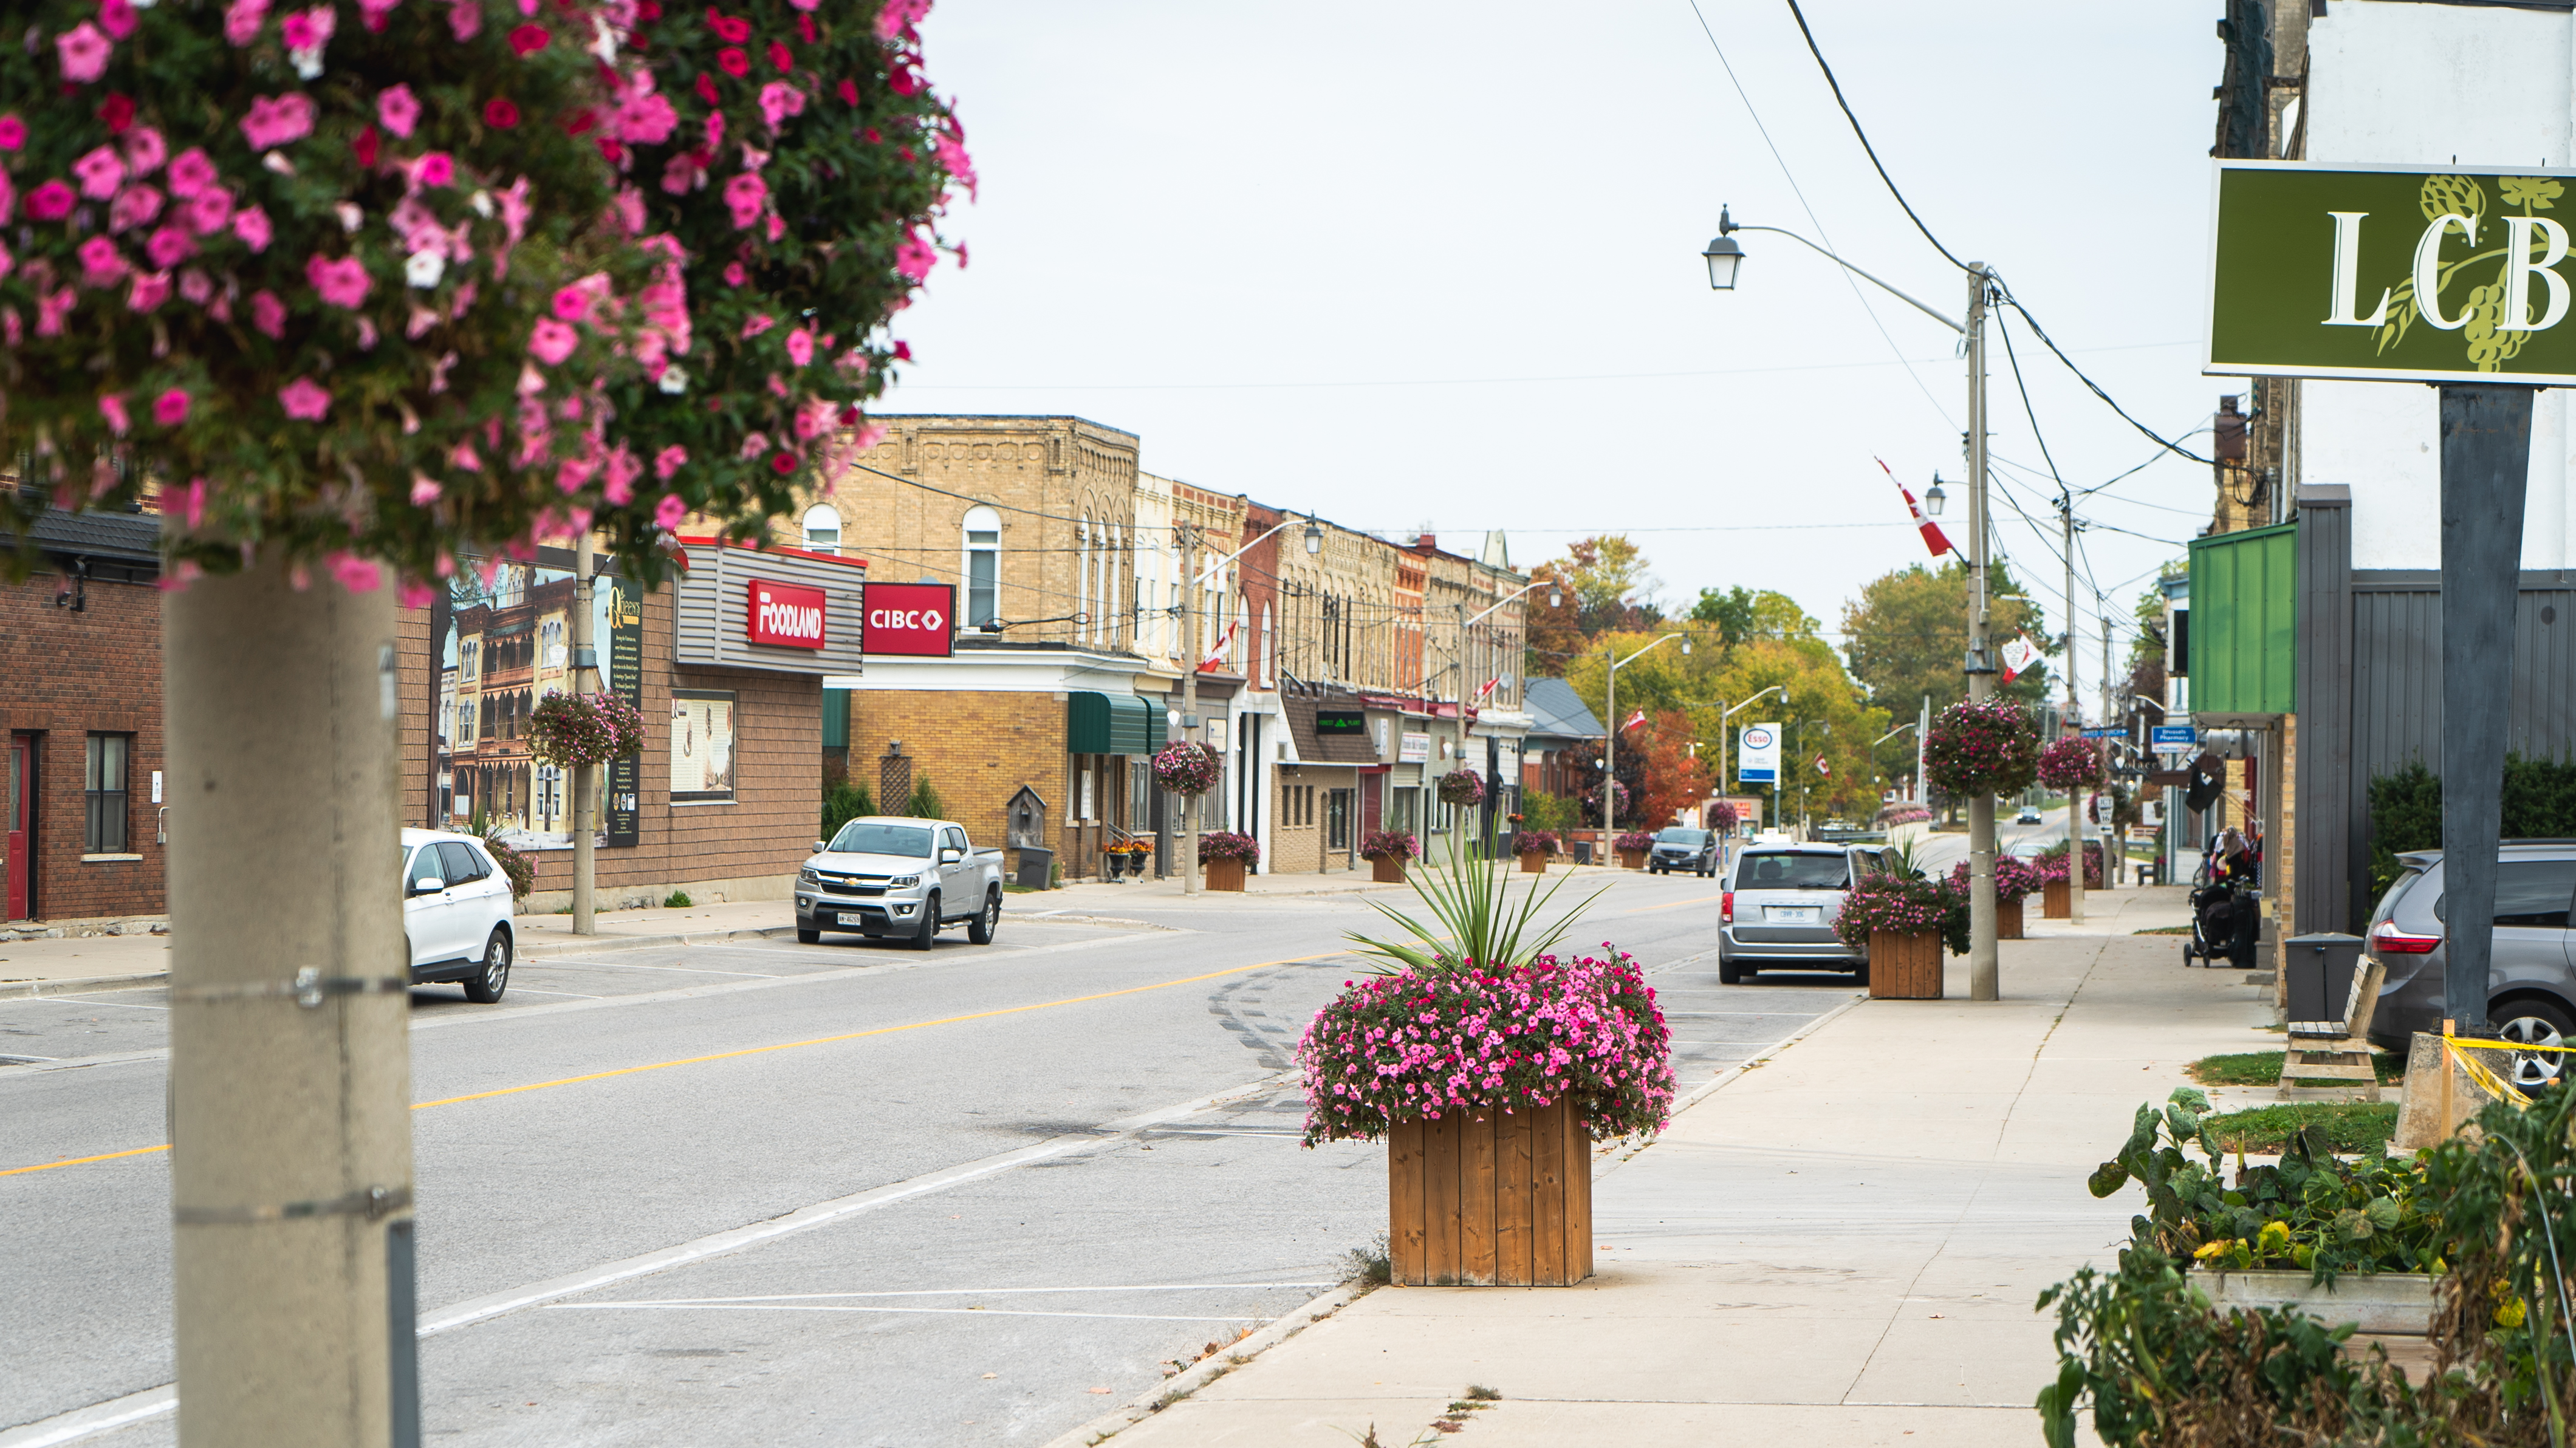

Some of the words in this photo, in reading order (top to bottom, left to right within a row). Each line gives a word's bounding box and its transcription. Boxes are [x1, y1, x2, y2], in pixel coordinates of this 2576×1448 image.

[759, 592, 821, 639] FOODLAND
[870, 609, 919, 629] CIBC
[1748, 734, 1768, 742] Esso
